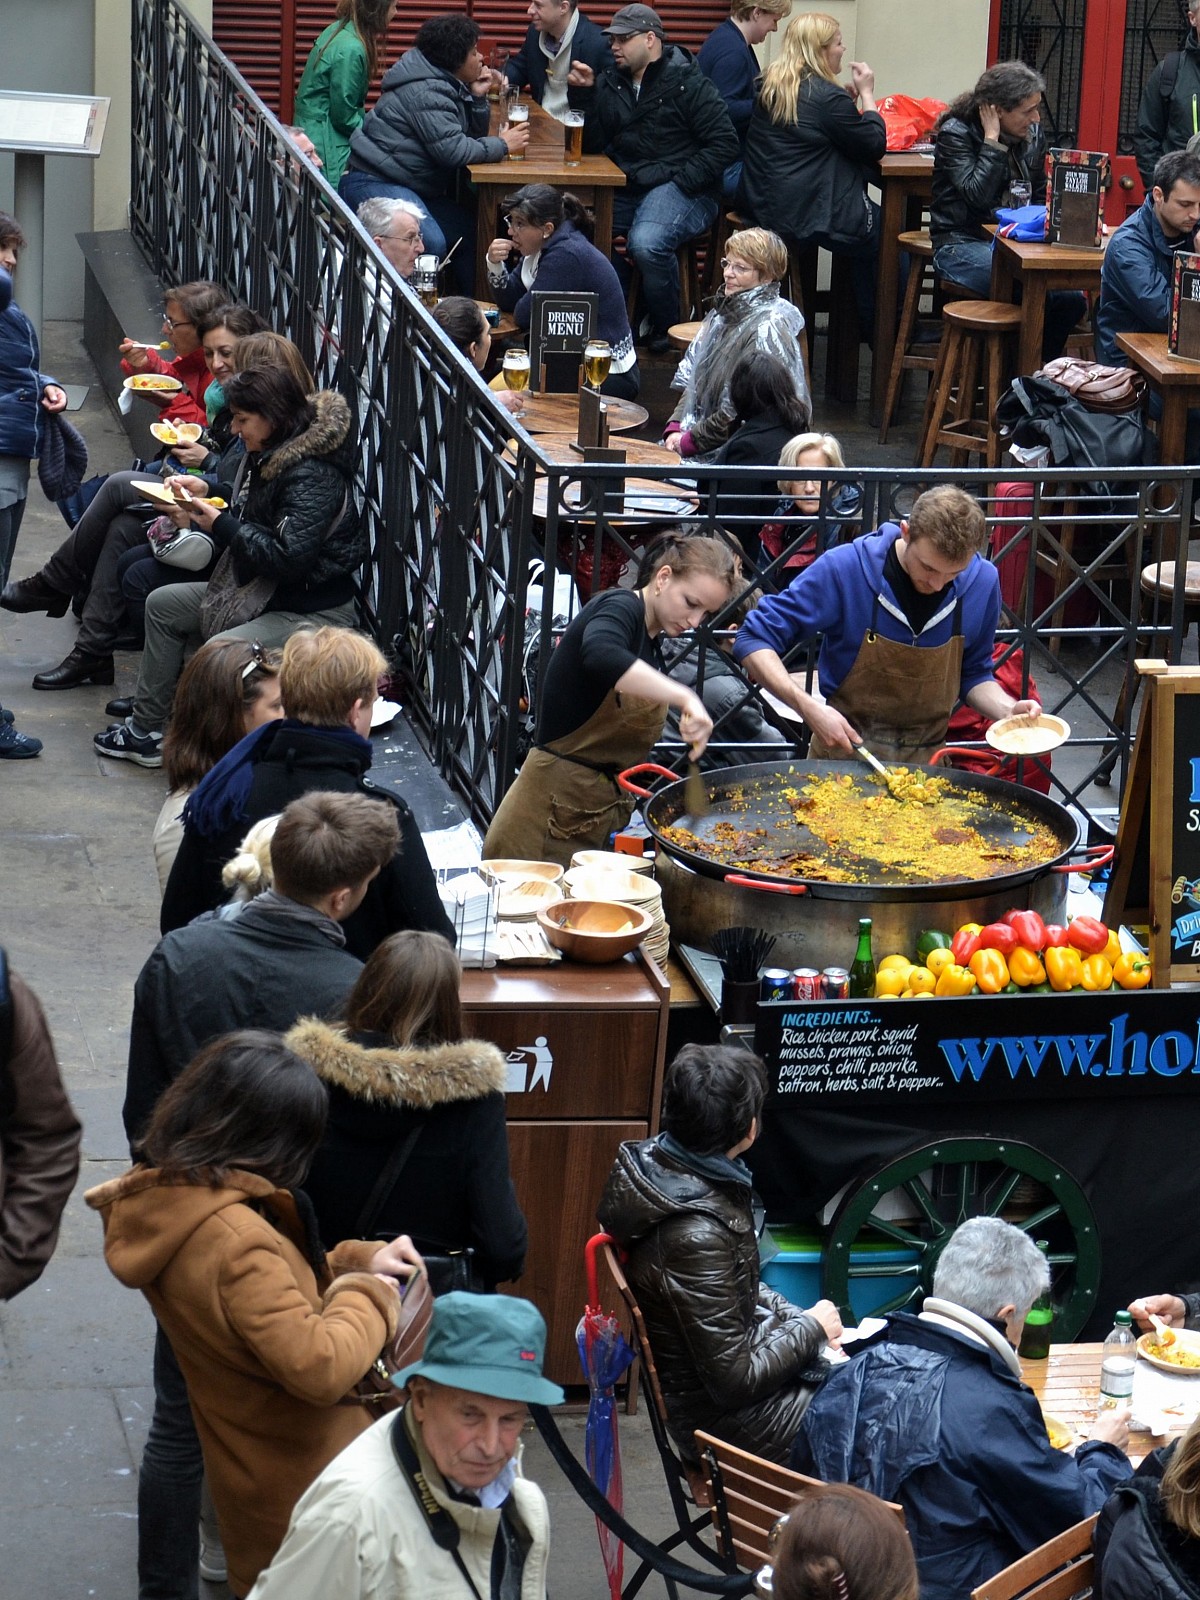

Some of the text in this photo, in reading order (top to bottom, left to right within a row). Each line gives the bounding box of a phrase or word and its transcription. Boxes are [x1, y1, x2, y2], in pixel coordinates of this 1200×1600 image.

[548, 311, 585, 323] DRINKS
[547, 322, 584, 336] MENU
[778, 1063, 833, 1079] peppers,
[777, 1079, 823, 1094] saffron,
[886, 1074, 897, 1088] &
